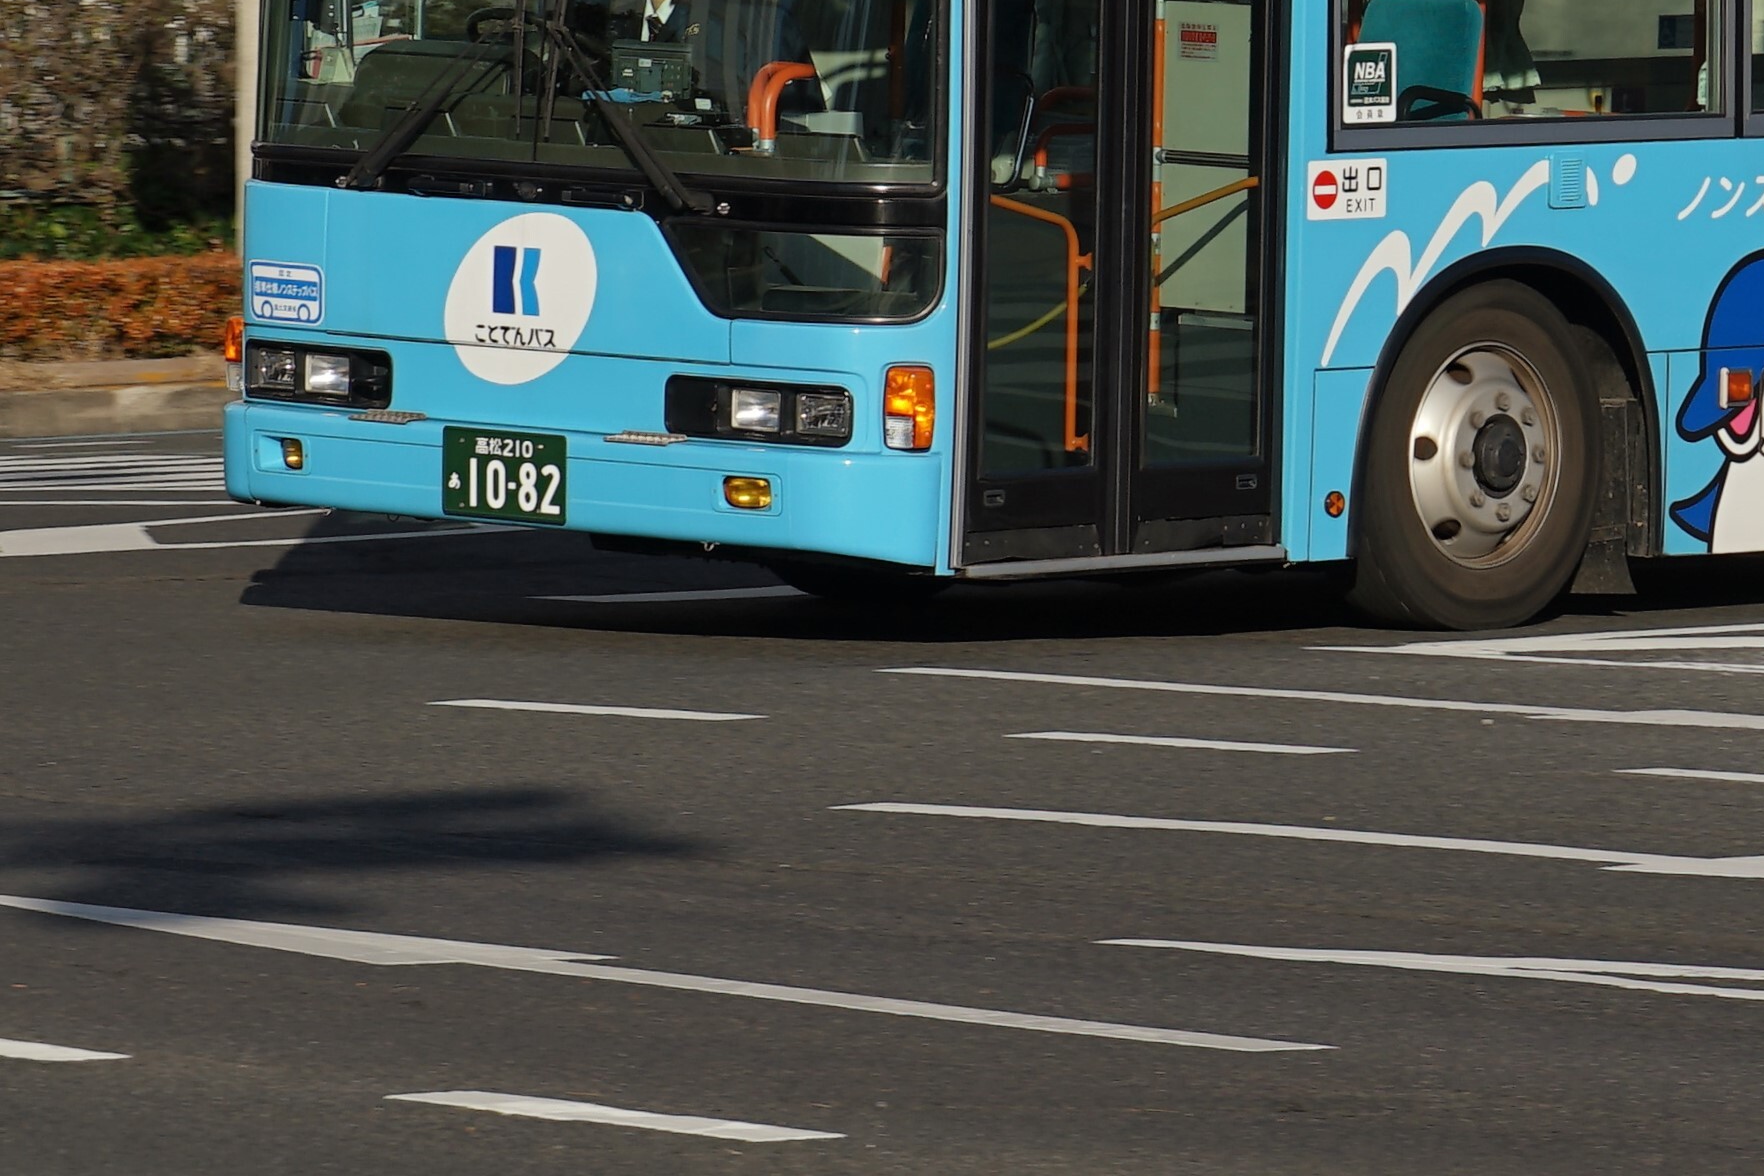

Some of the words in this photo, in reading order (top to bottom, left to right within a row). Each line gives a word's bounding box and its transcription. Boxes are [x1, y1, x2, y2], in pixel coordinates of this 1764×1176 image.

[1354, 61, 1386, 81] NBA
[1342, 166, 1382, 193] 出口
[1346, 198, 1376, 213] EXIT
[475, 325, 556, 348] ことでんバス
[475, 437, 534, 458] 高松210
[448, 472, 461, 489] あ
[469, 457, 561, 515] 10-82
